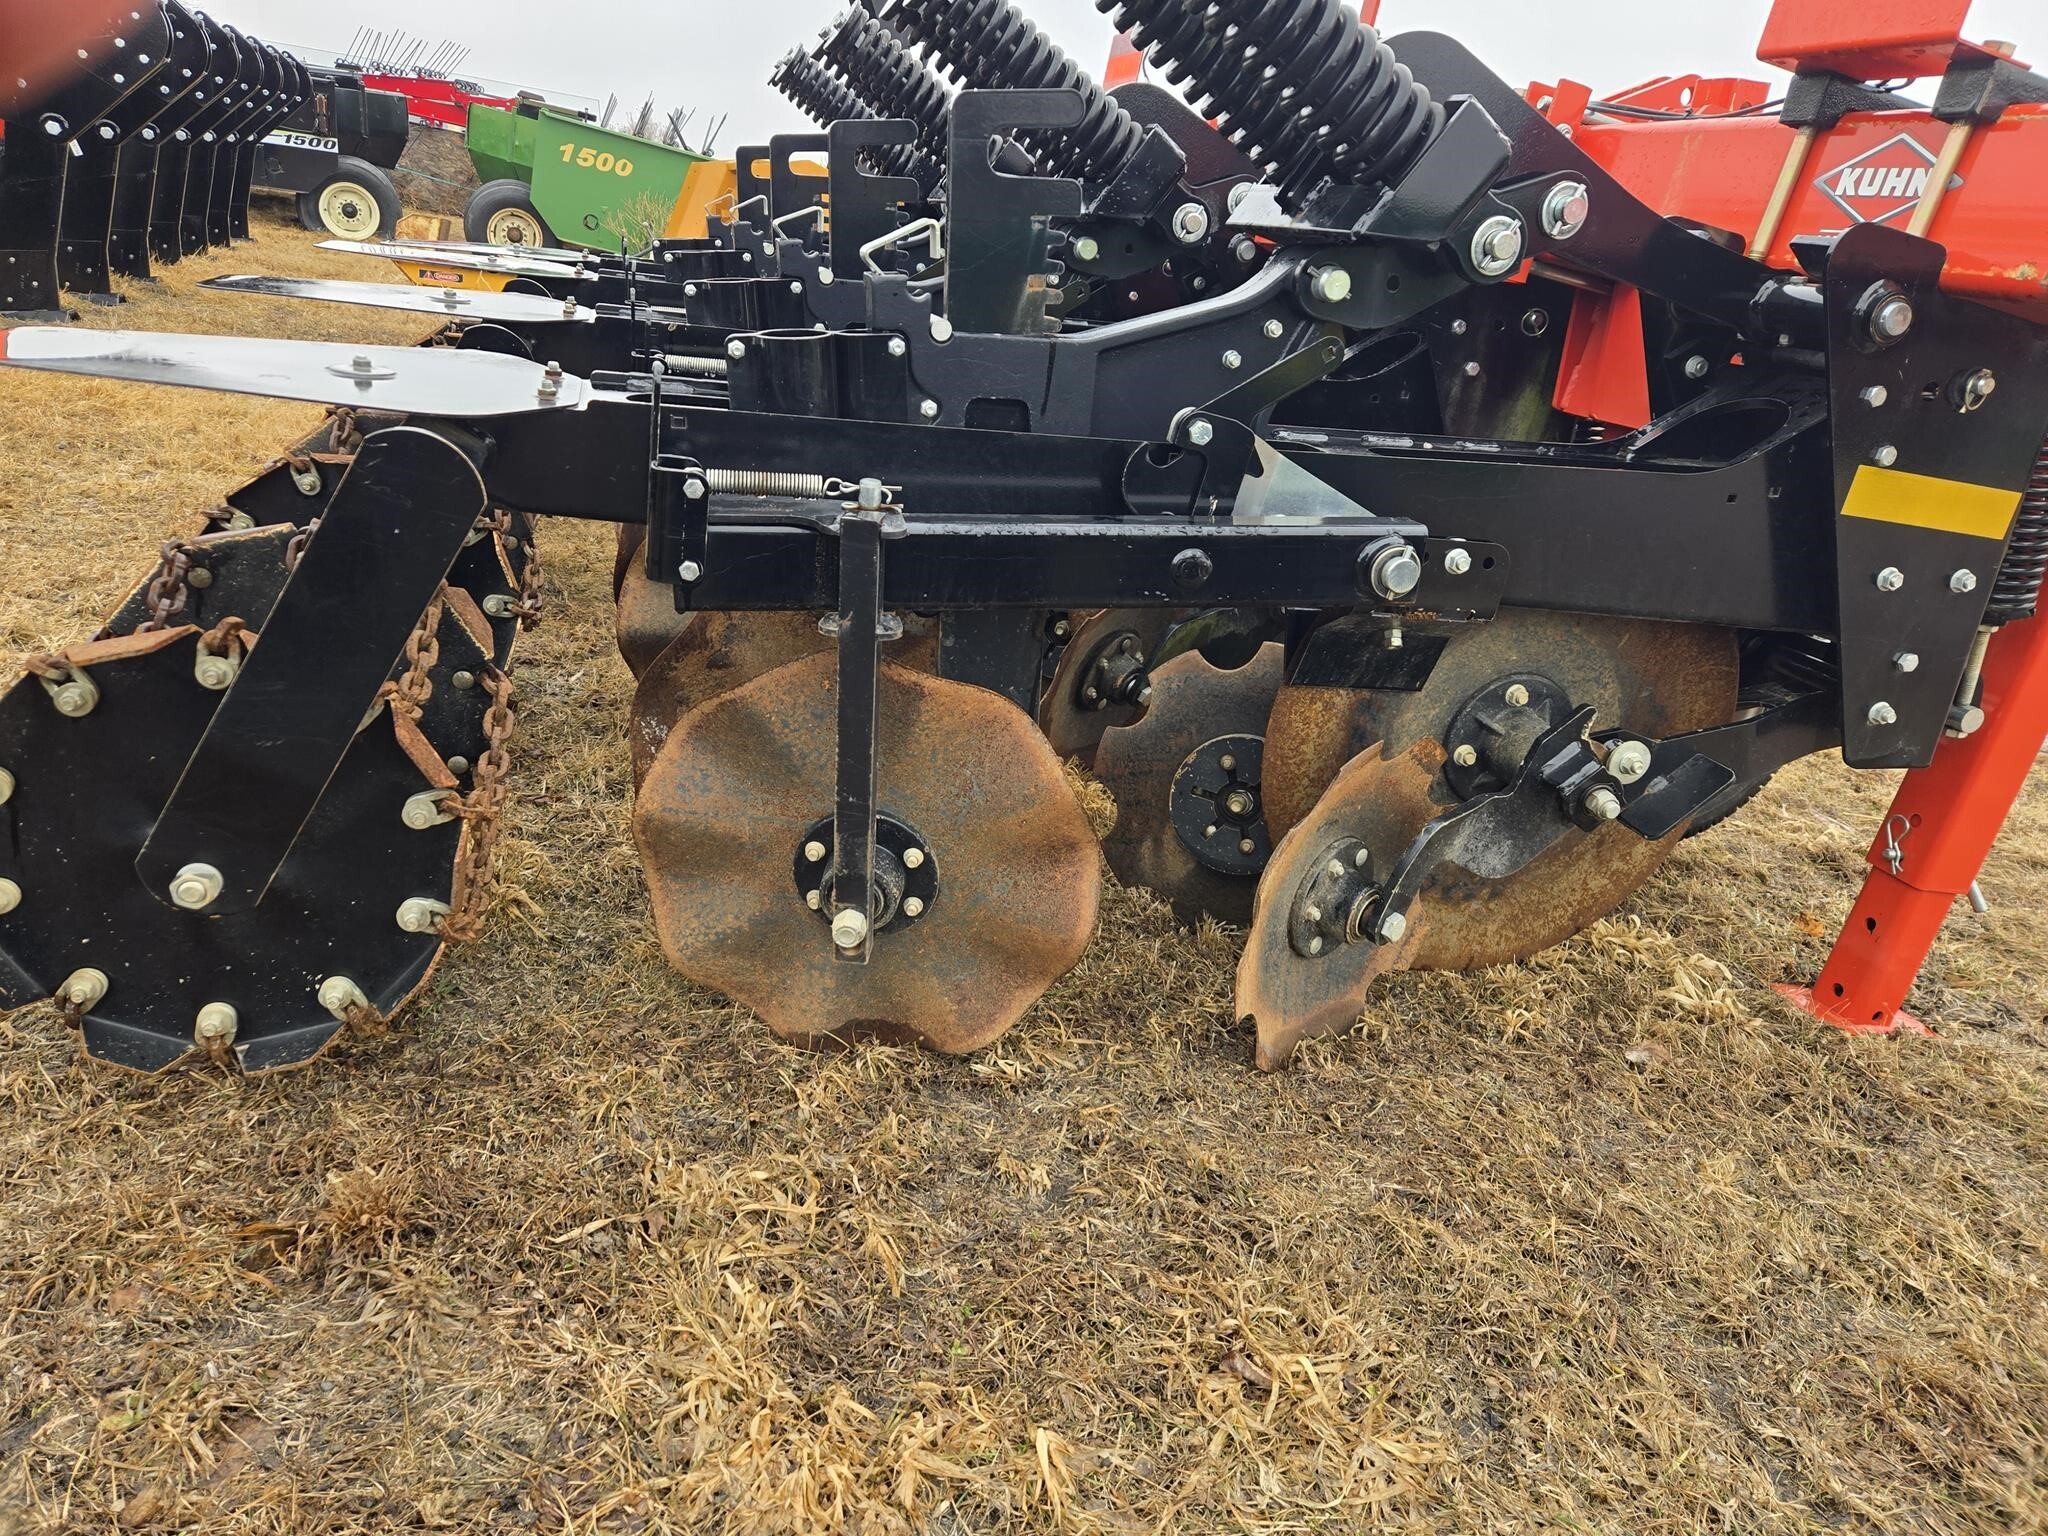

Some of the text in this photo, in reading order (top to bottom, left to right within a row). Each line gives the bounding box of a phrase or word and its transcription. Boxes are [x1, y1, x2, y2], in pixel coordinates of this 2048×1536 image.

[284, 134, 337, 149] 1500
[559, 143, 634, 177] 1500
[1834, 167, 1933, 197] KUHN
